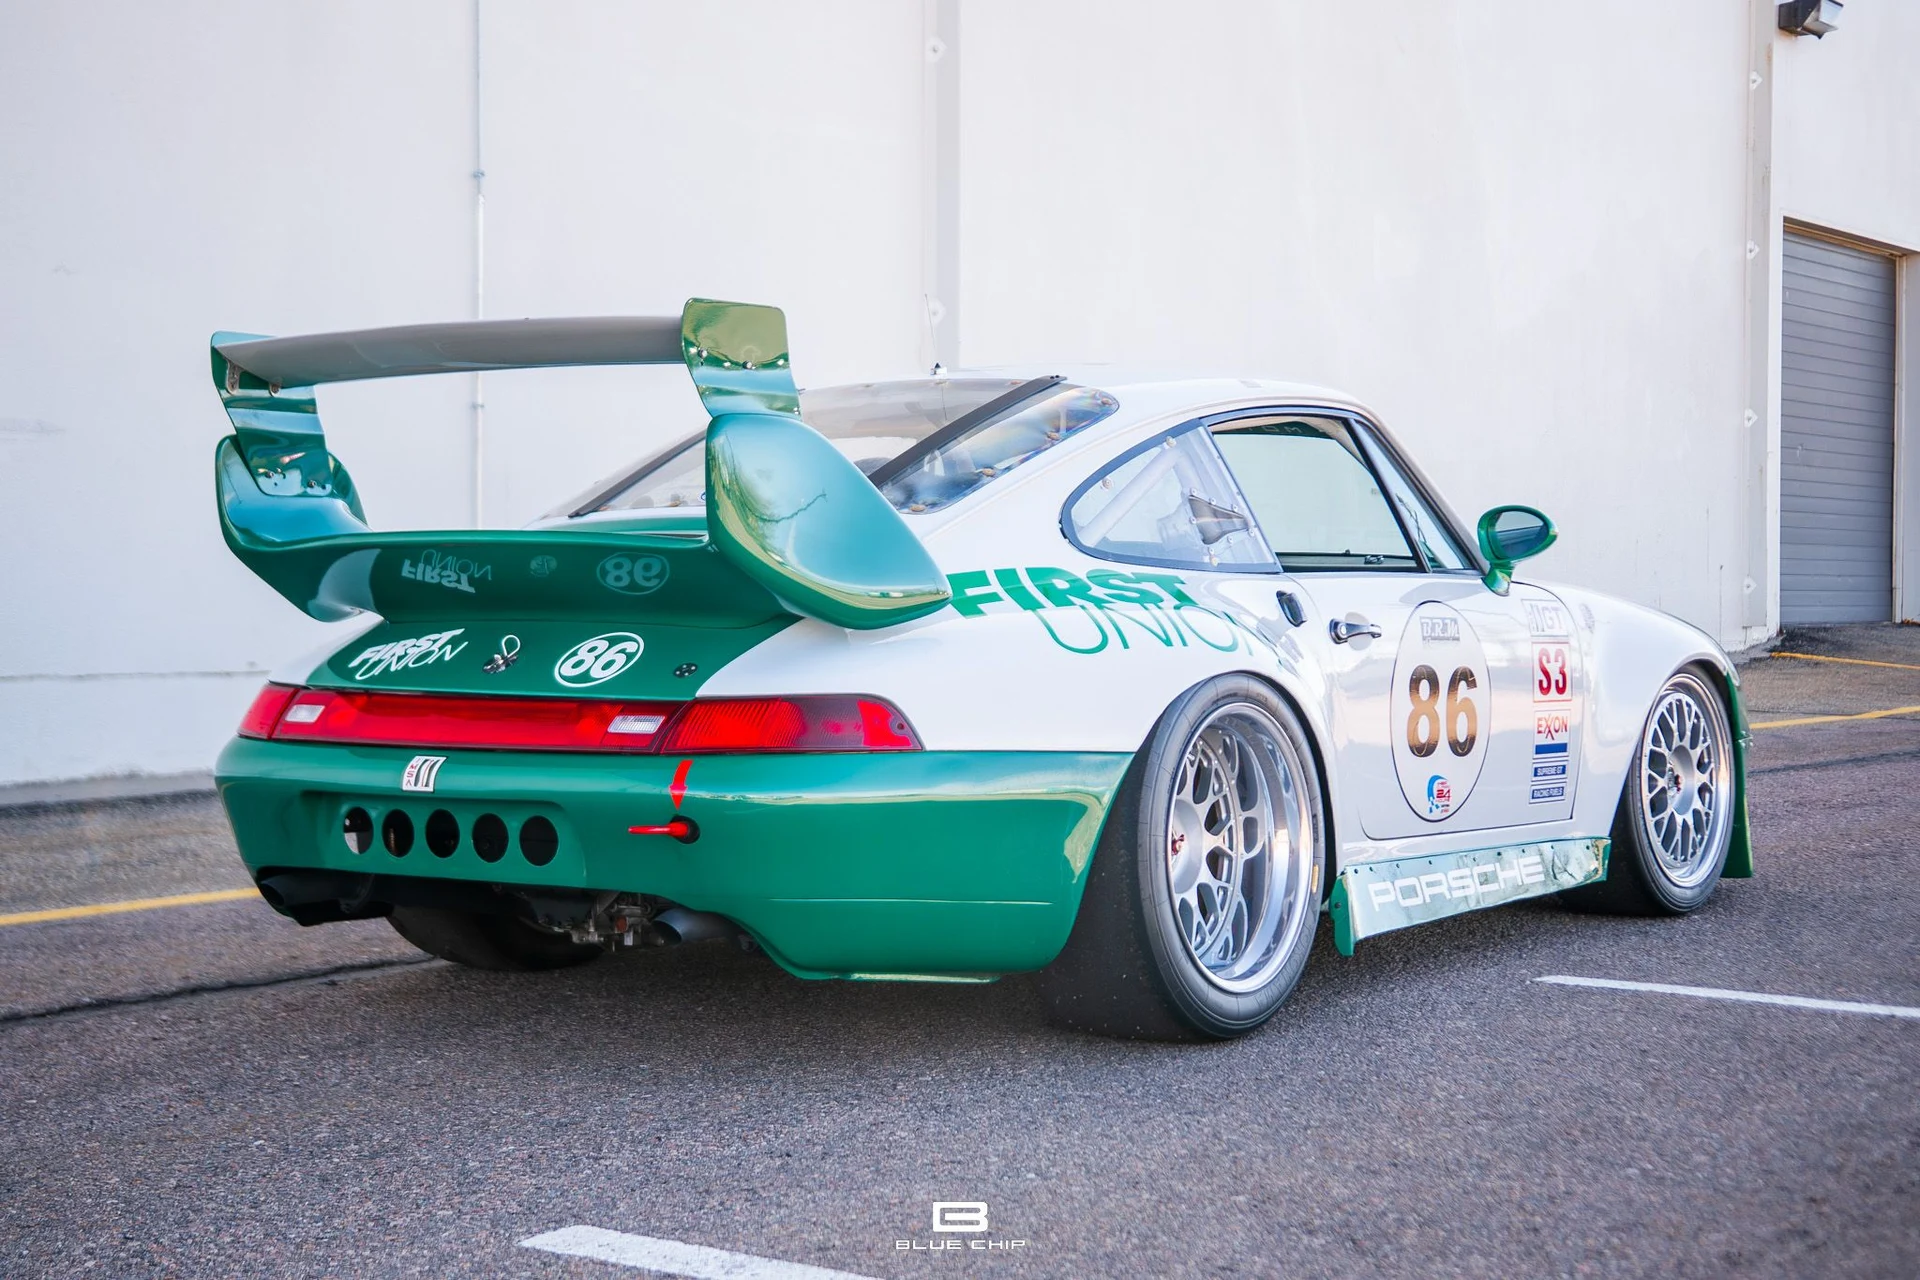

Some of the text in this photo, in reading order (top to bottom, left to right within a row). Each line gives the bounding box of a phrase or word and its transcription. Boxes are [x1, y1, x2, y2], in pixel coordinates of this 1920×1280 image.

[946, 566, 1199, 618] FIRST
[348, 628, 466, 668] FIRST
[355, 641, 469, 680] UNION
[559, 639, 639, 679] 86
[1538, 647, 1568, 696] S3
[1406, 664, 1478, 758] 86
[1536, 713, 1569, 741] EXXON
[1367, 855, 1546, 912] PORSCHE
